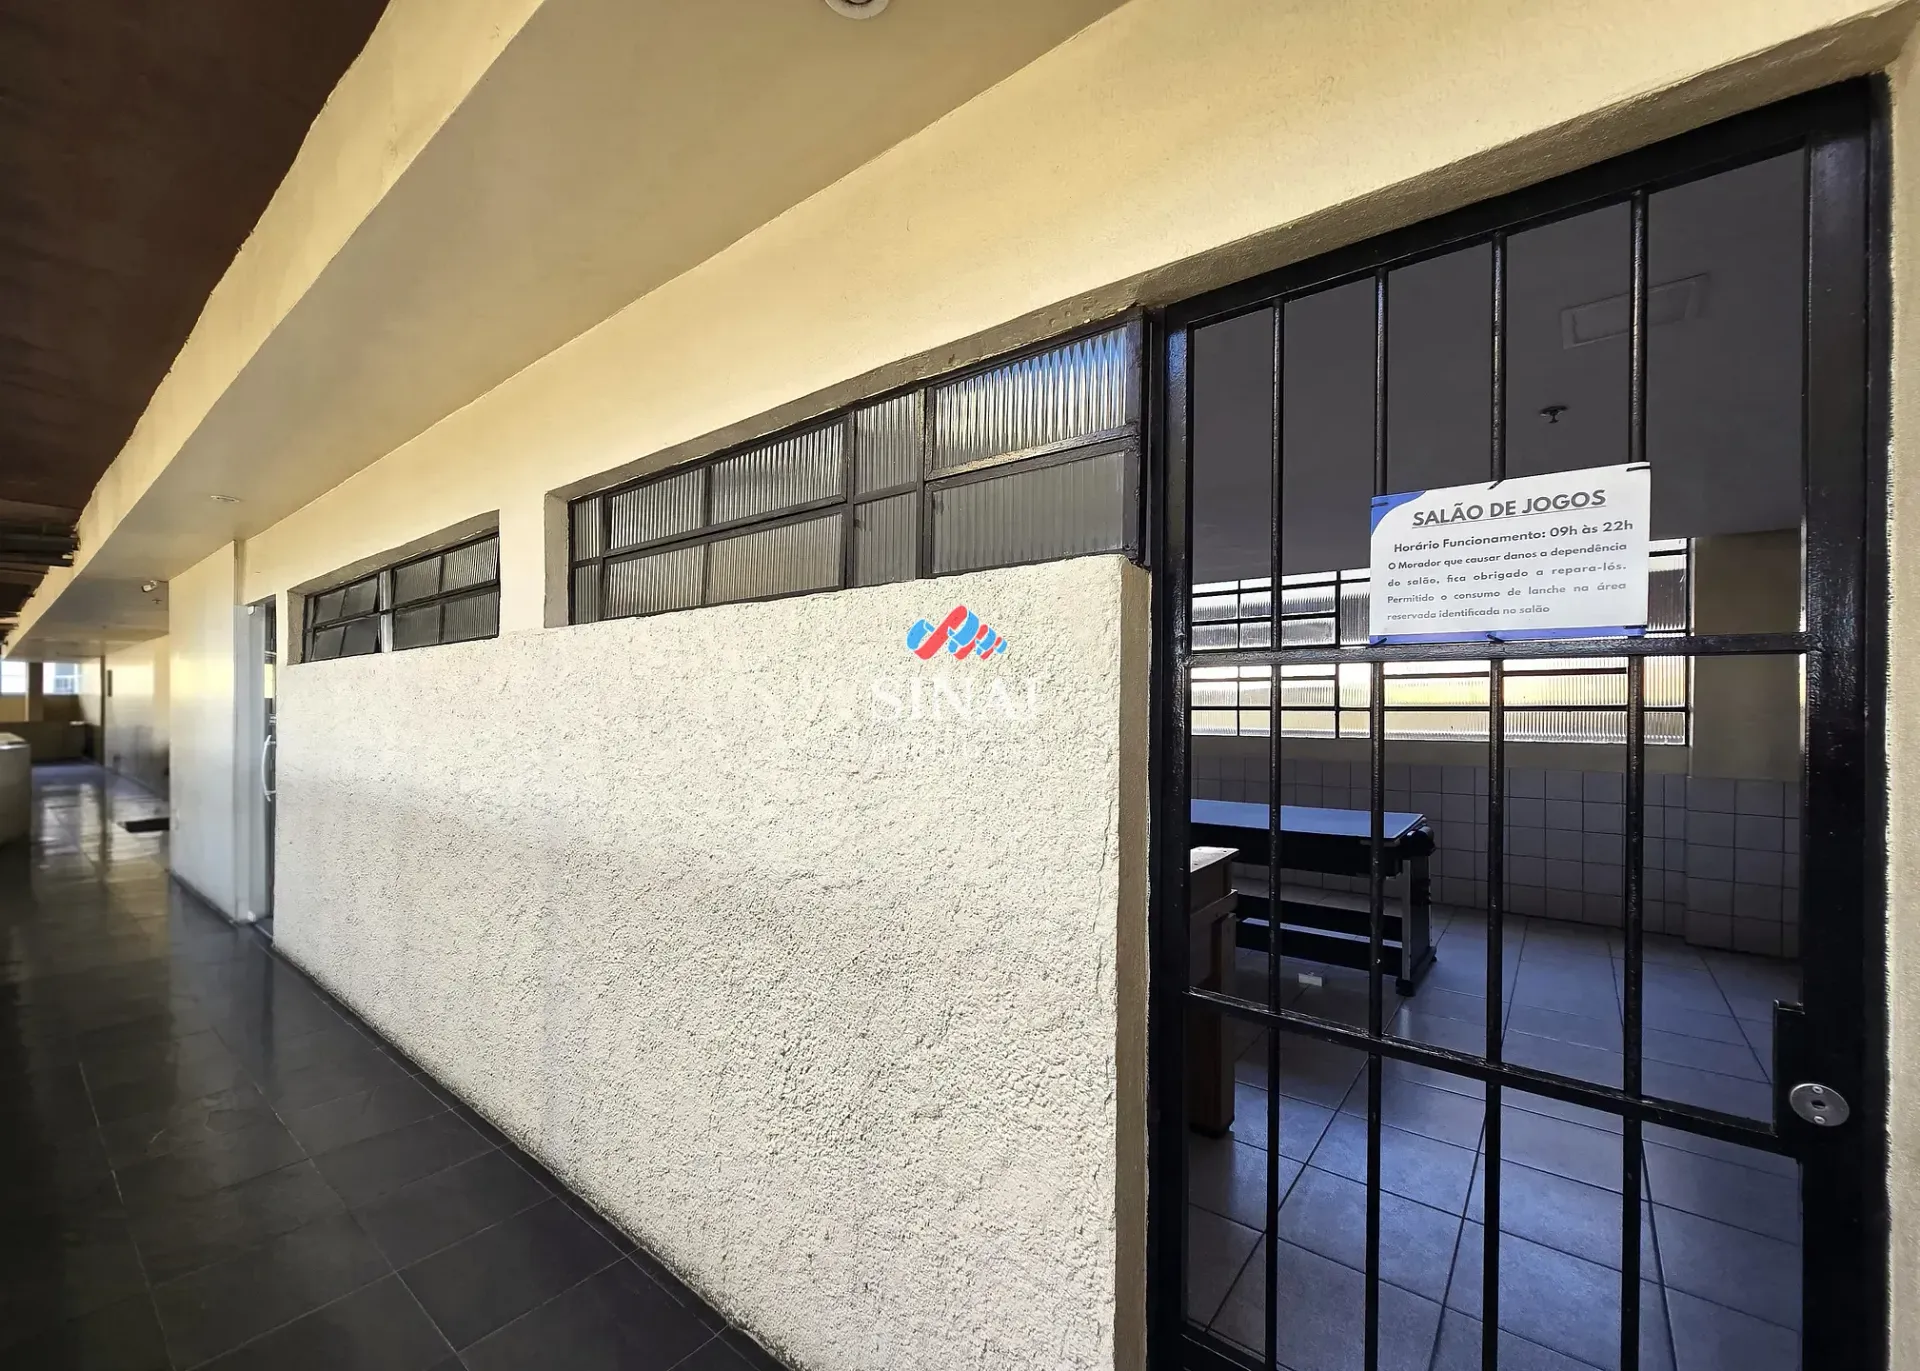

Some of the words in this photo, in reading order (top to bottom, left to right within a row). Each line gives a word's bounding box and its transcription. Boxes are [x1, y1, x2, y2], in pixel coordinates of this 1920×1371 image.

[1412, 502, 1484, 526] SALÃO
[1490, 500, 1516, 518] DE
[1521, 489, 1606, 514] JOGOS
[1394, 541, 1439, 552] Horário
[1443, 531, 1546, 548] Funcionamento:
[1550, 525, 1577, 538] 09h
[1581, 525, 1599, 535] às
[1603, 520, 1633, 533] 22h
[1388, 562, 1396, 570] O
[1398, 559, 1441, 569] Morador
[1443, 559, 1463, 567] que
[1465, 555, 1501, 564] causar
[1503, 551, 1537, 560] danos
[1550, 542, 1627, 557] dependência
[1387, 579, 1401, 587] do
[1447, 574, 1466, 583] fica
[1473, 569, 1528, 581] obrigado
[1387, 594, 1435, 604] Permitido
[1454, 591, 1500, 600] consumo
[1507, 587, 1521, 596] de
[1528, 585, 1566, 595] lanche
[1597, 582, 1626, 591] área
[1387, 611, 1437, 621] reservada
[1439, 607, 1500, 618] identificada
[1519, 605, 1550, 614] salão
